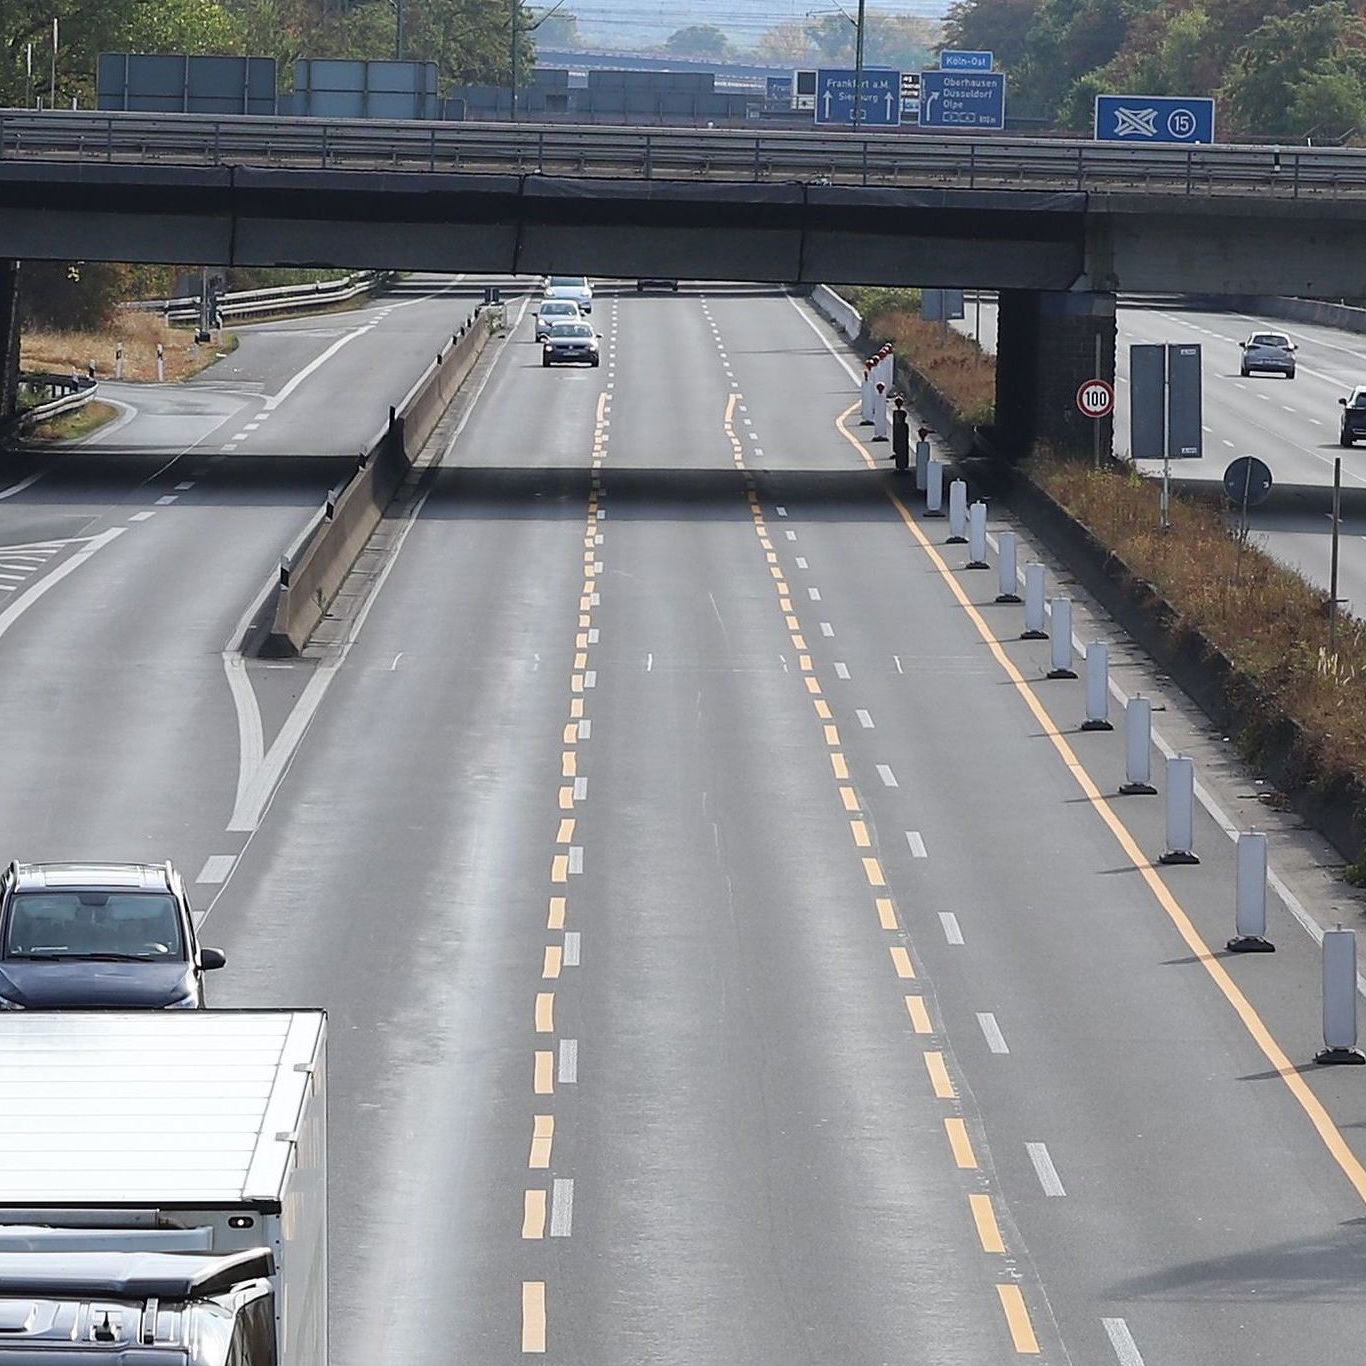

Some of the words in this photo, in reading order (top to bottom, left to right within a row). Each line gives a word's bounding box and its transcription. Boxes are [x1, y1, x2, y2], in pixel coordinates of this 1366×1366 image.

[827, 79, 869, 88] Frankfrt
[944, 77, 997, 87] Oberhausen
[943, 99, 963, 109] Olpe
[1174, 115, 1190, 132] 15
[1086, 391, 1107, 407] 100
